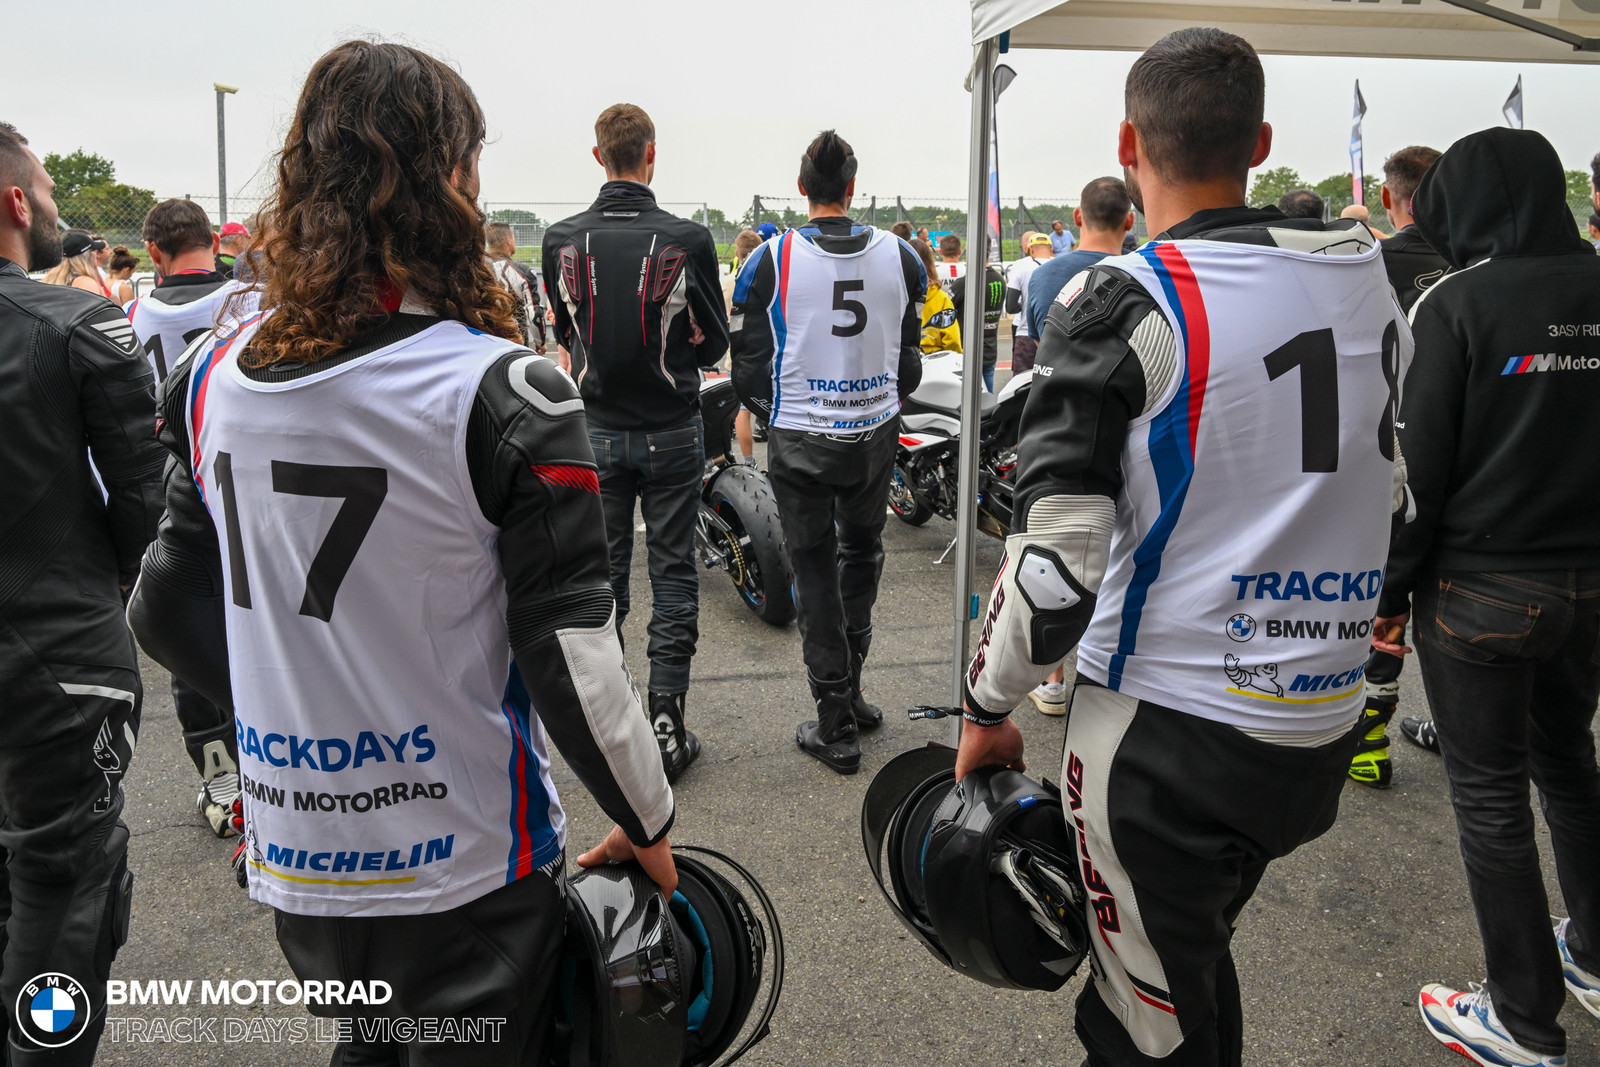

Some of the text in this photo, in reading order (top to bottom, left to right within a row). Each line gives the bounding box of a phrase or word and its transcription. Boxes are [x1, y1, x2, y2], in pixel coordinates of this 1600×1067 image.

[831, 279, 868, 338] 5
[807, 373, 889, 393] TRACKDAYS
[823, 392, 889, 408] BMW MOTORRAD
[1263, 318, 1400, 473] 18
[833, 411, 891, 428] MICHELIN
[213, 450, 388, 623] 17
[1266, 620, 1330, 640] BMW
[235, 715, 436, 773] RACKDAYS
[243, 774, 448, 813] BMW MOTORRAD
[266, 834, 455, 873] MICHELIN
